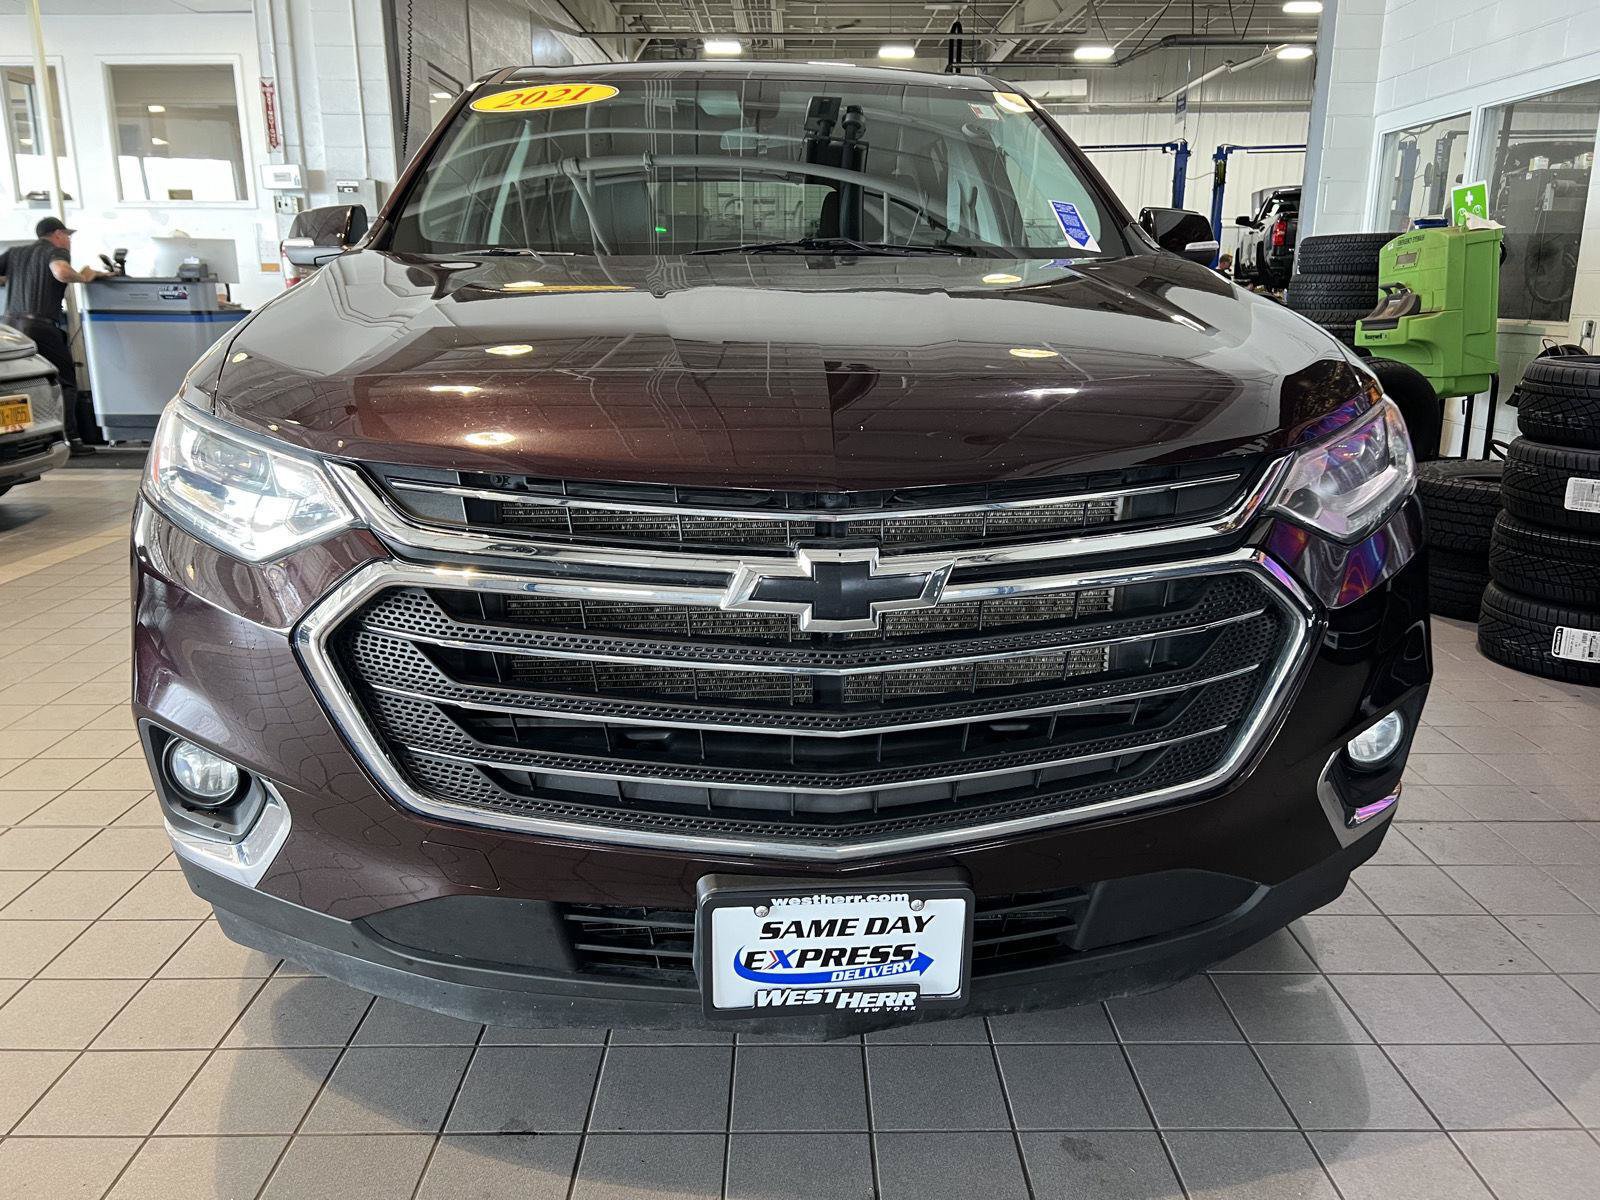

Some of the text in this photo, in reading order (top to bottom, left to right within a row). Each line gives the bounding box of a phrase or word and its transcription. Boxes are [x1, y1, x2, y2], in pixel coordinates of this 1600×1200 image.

[494, 86, 593, 109] 2021
[770, 893, 909, 907] westherr.com
[759, 914, 936, 940] SAME DAY
[744, 944, 917, 970] EXPRESS
[831, 960, 916, 982] DELIVERY
[855, 1005, 876, 1013] NEW
